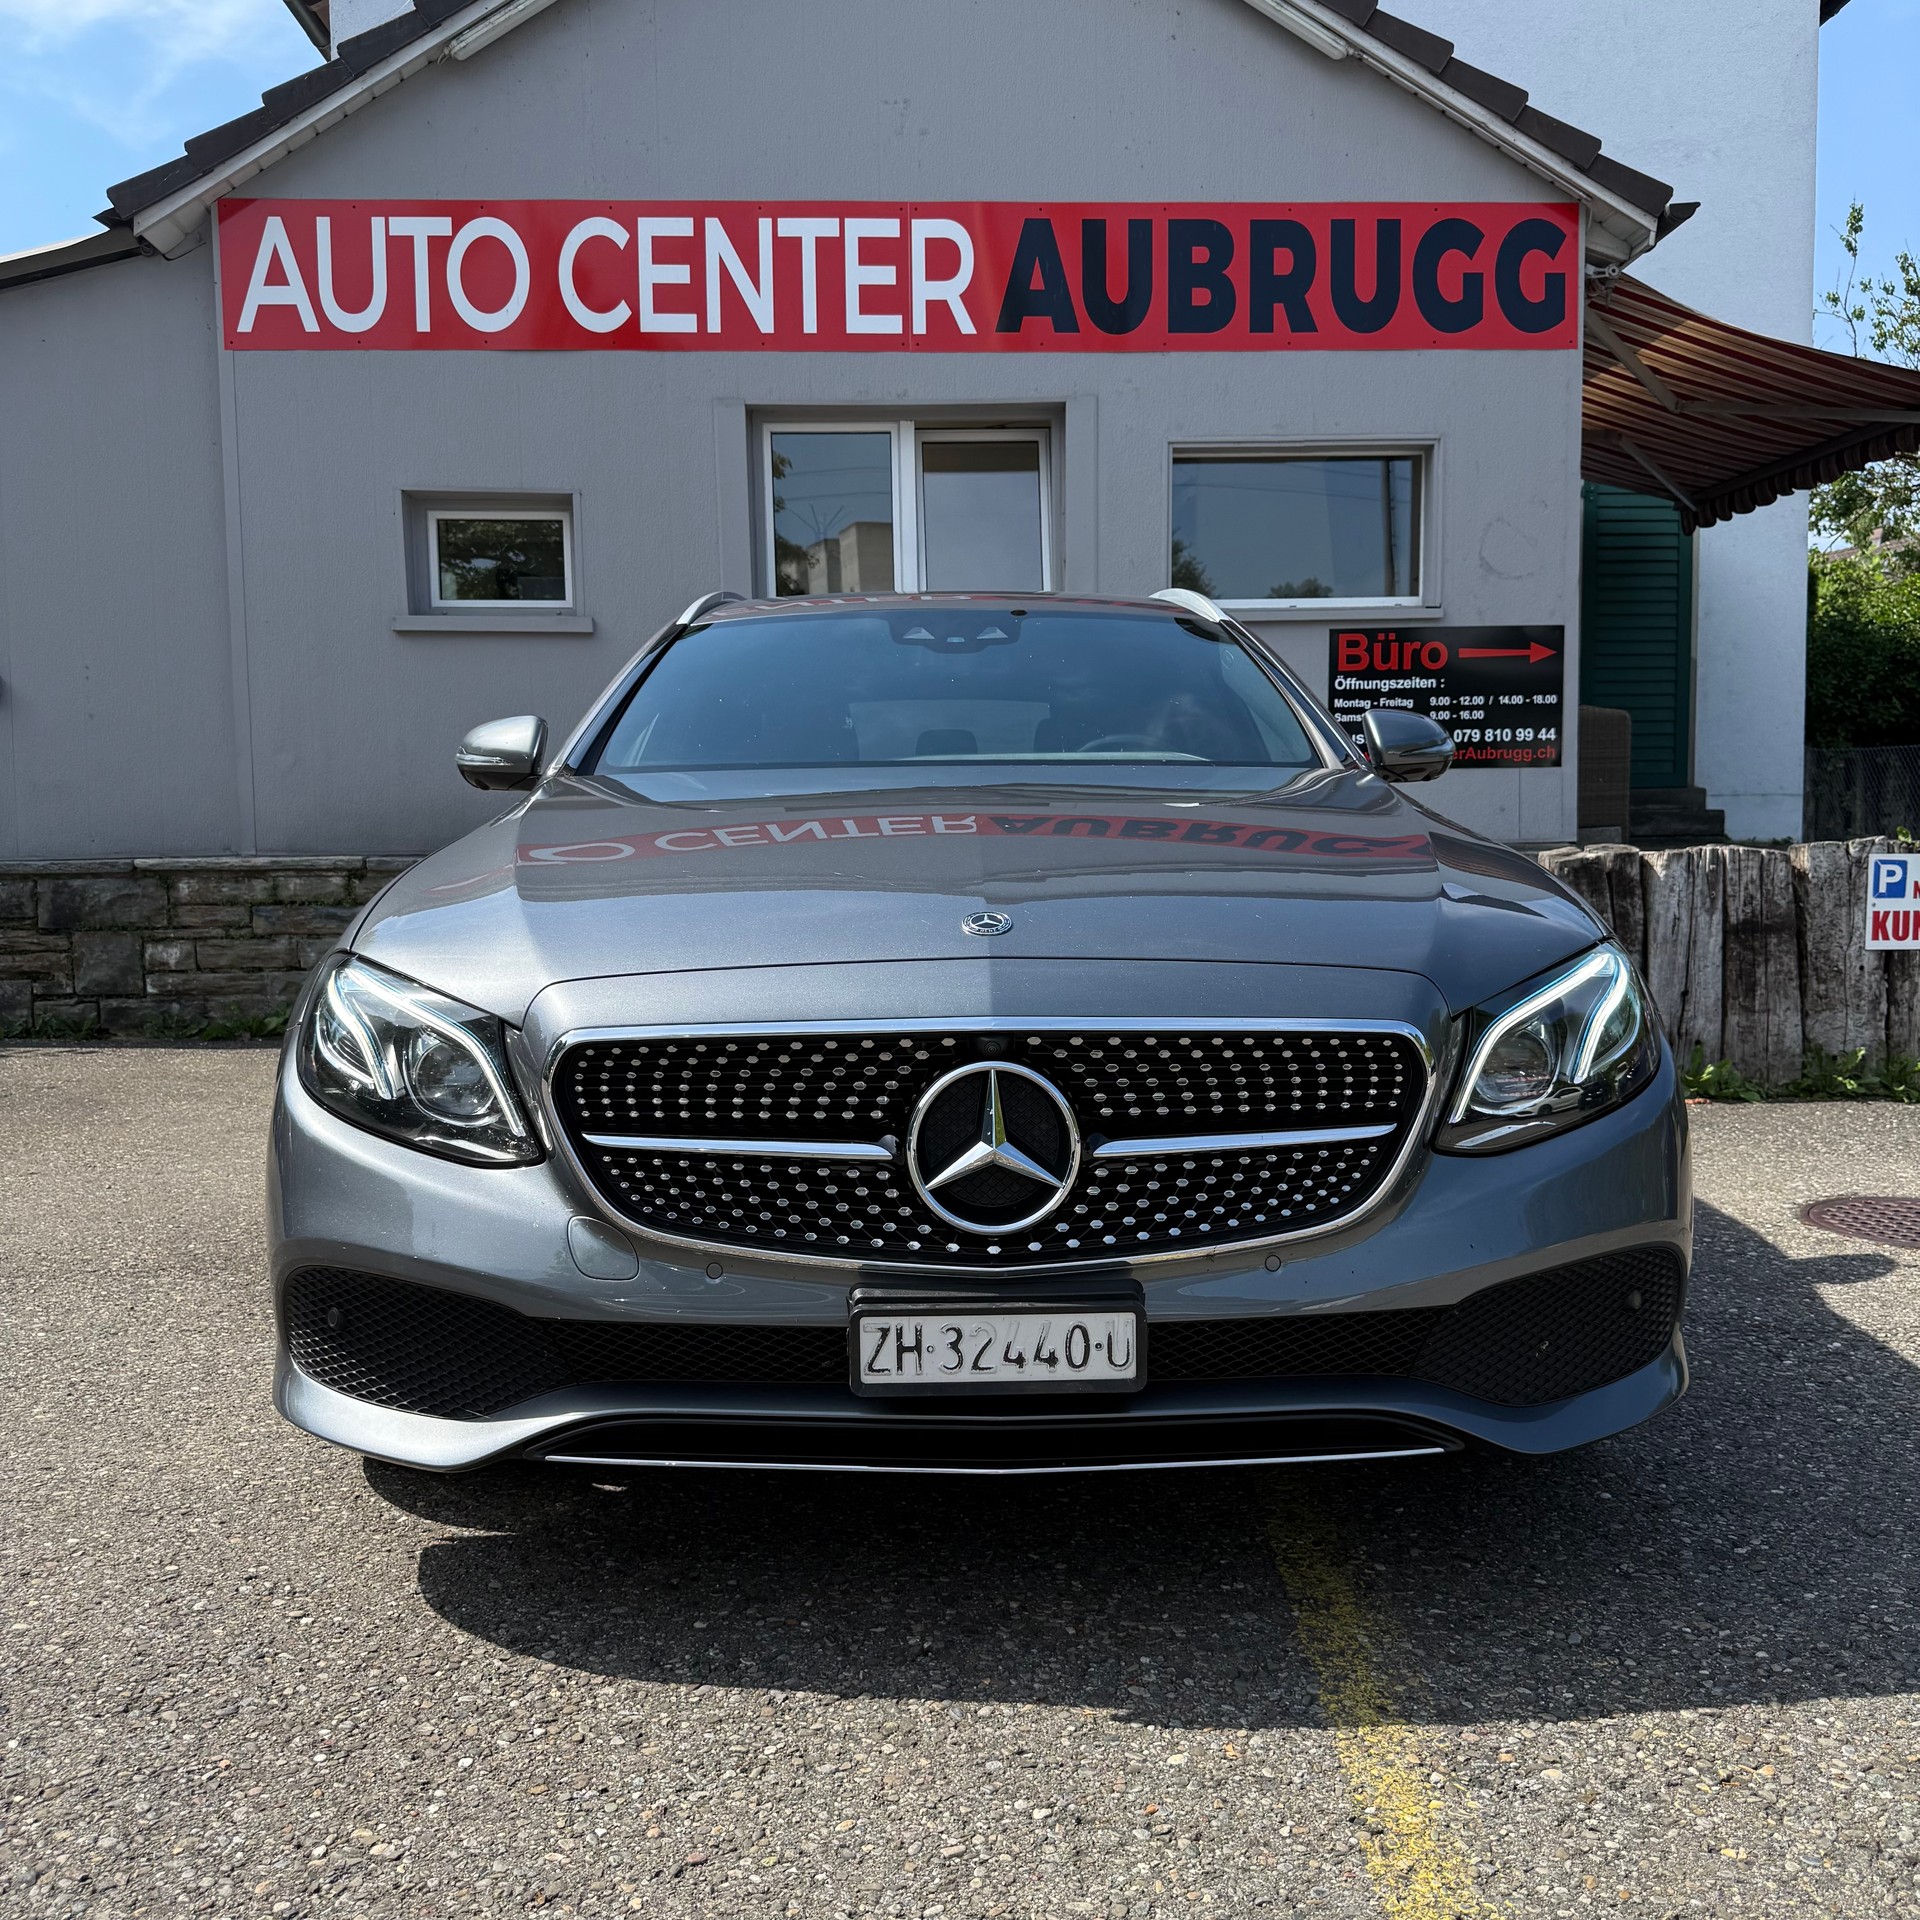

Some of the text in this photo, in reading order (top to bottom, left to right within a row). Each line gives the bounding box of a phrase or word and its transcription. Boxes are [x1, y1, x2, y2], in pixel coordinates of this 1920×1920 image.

[236, 215, 1567, 336] AUTO CENTER AUBRUGG
[1337, 632, 1449, 671] Büro
[1334, 675, 1437, 692] Öffnungszeiten
[1334, 698, 1371, 710] Montag
[1379, 697, 1414, 709] Freitag
[1429, 696, 1450, 706] 9.00
[1459, 696, 1484, 706] 12.00
[1498, 695, 1523, 705] 14.00
[1532, 694, 1557, 704] 18.00
[1429, 711, 1450, 720] 9.00
[1459, 710, 1484, 720] 16.00
[1453, 727, 1556, 743] 079 810 99 44
[1453, 745, 1556, 762] erAubrugg.ch
